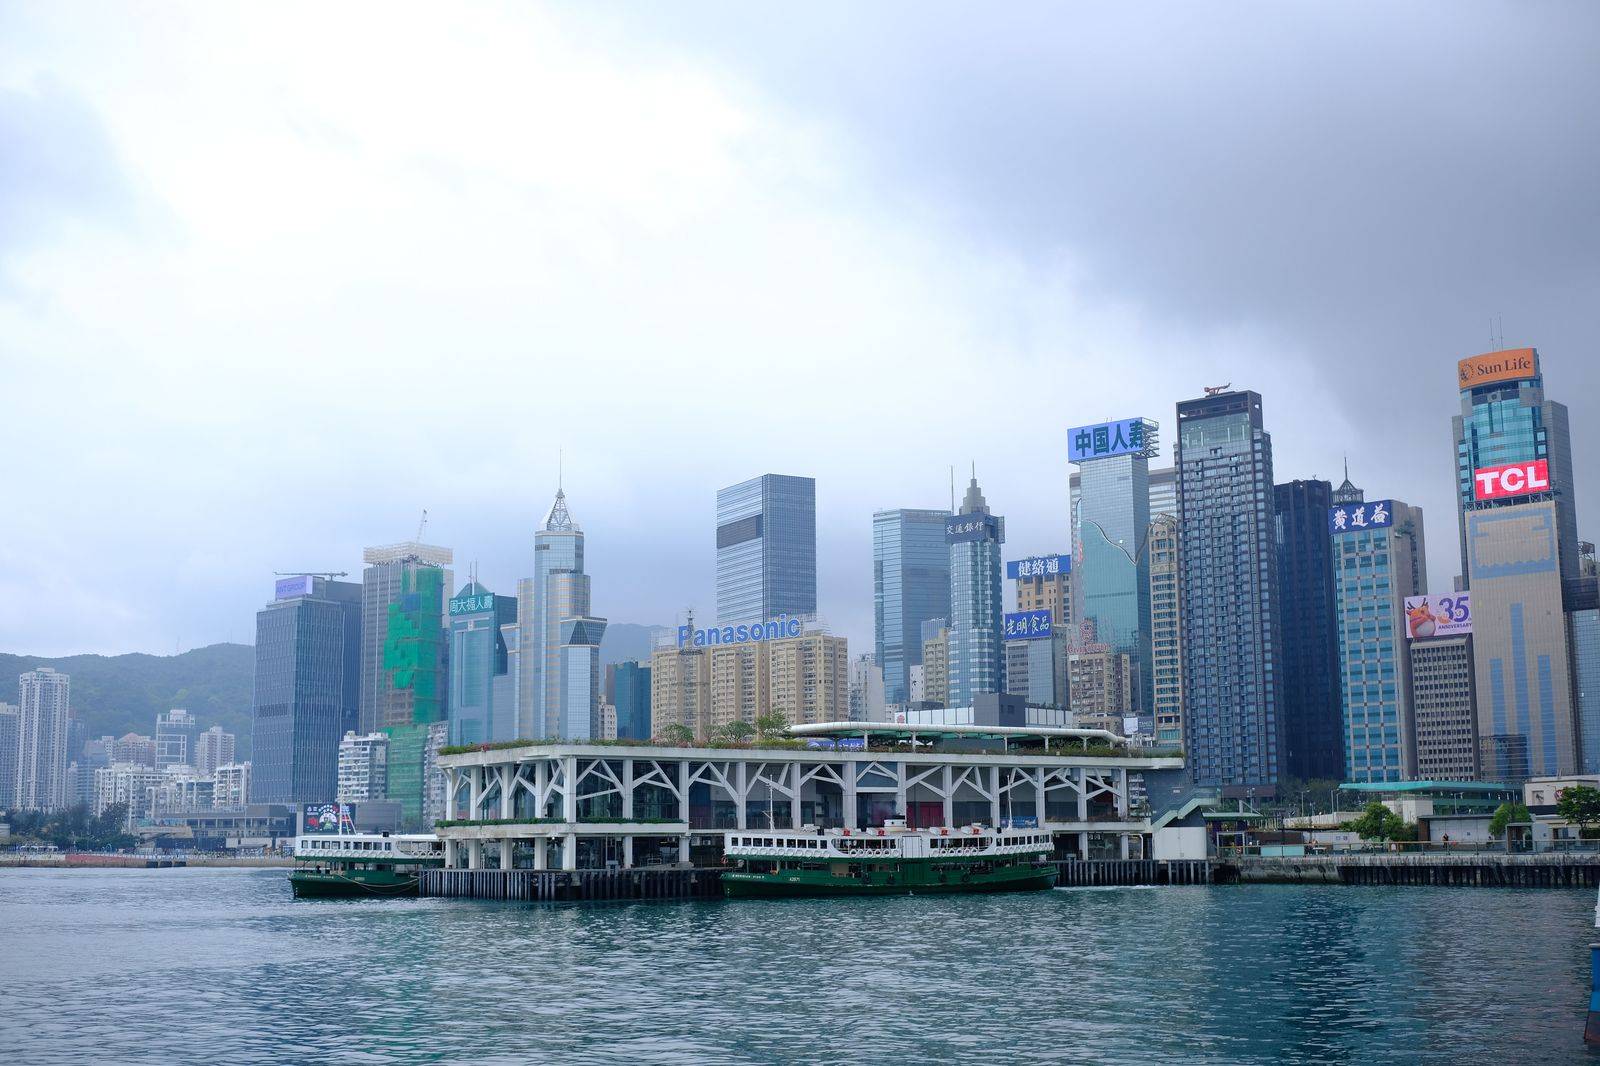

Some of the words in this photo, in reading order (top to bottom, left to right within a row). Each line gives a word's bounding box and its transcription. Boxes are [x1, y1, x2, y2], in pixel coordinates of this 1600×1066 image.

[1477, 363, 1502, 376] Sun
[1505, 357, 1531, 371] Life
[1475, 466, 1548, 494] TCL
[1439, 596, 1469, 622] 35
[678, 613, 800, 649] Panasonic
[1006, 614, 1049, 635] 光明食品
